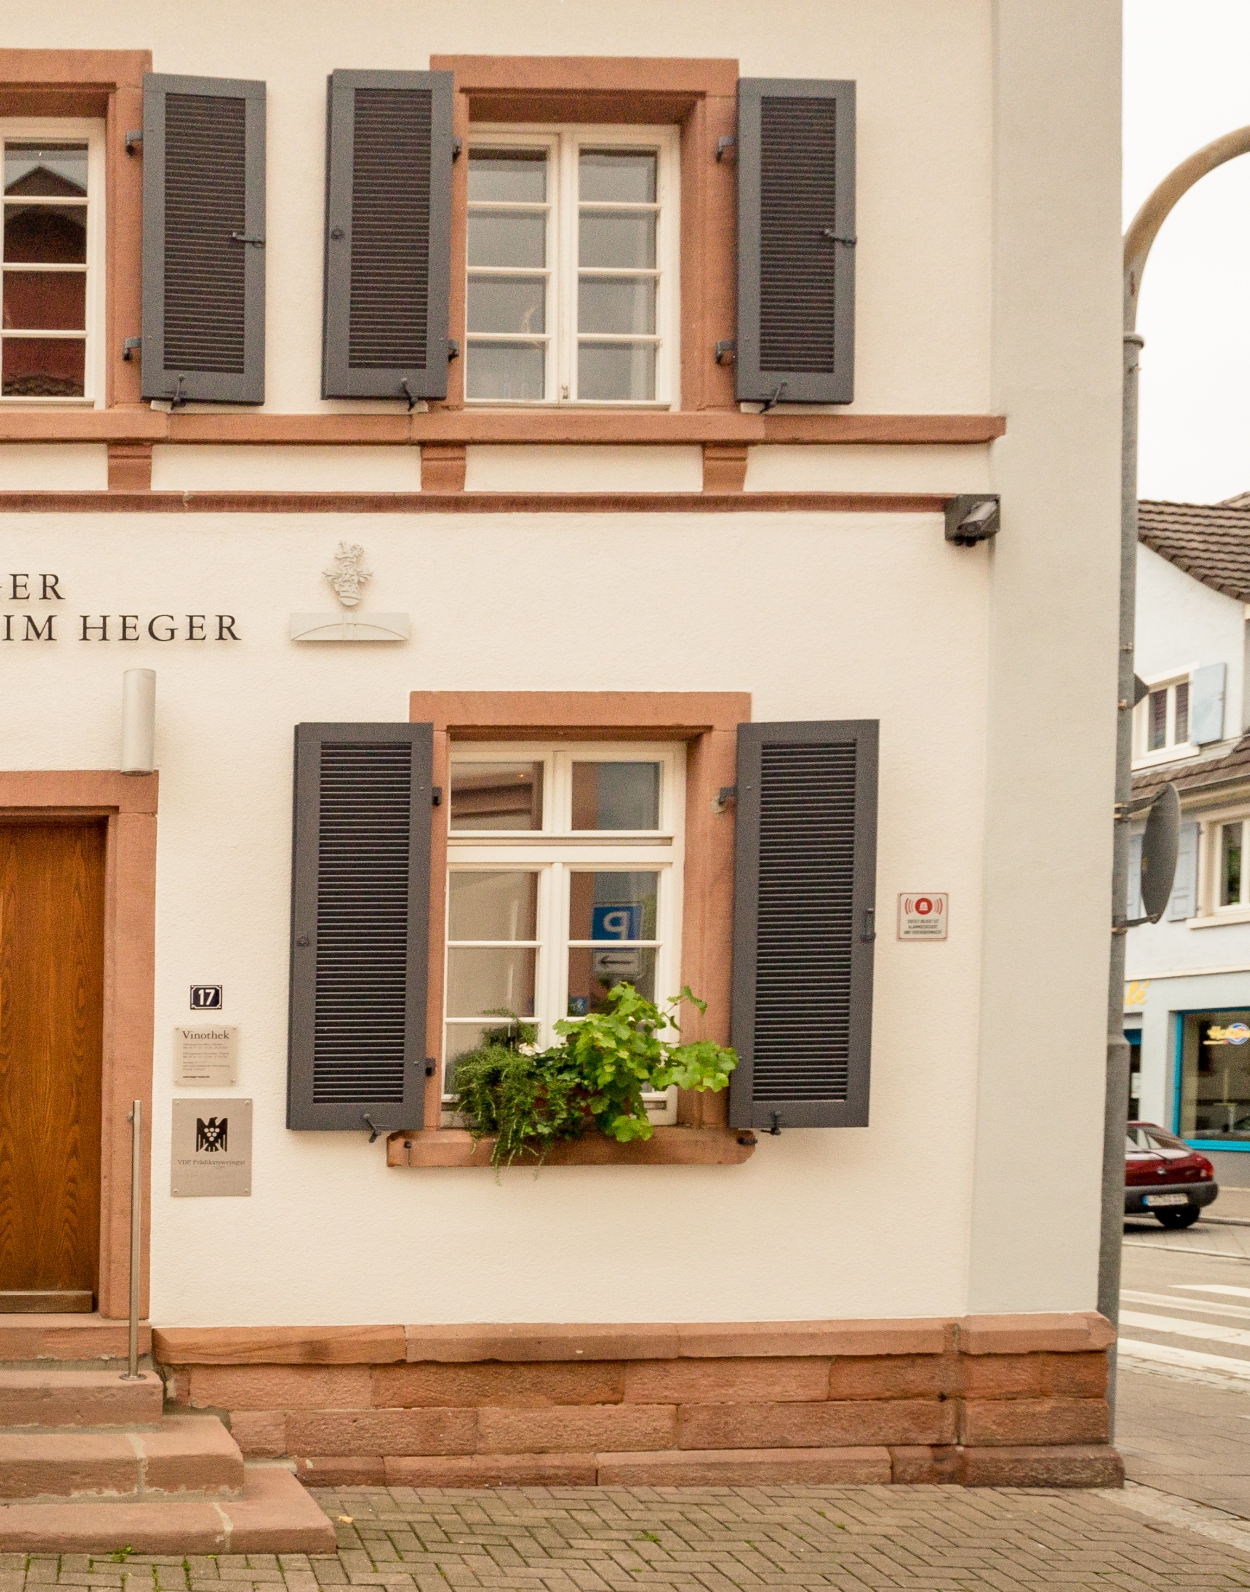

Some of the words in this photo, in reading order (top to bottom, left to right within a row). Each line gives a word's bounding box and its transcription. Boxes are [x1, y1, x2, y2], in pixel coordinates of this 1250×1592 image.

[79, 614, 242, 642] HEGER
[198, 988, 216, 1006] 17
[182, 1030, 230, 1040] Vinothek
